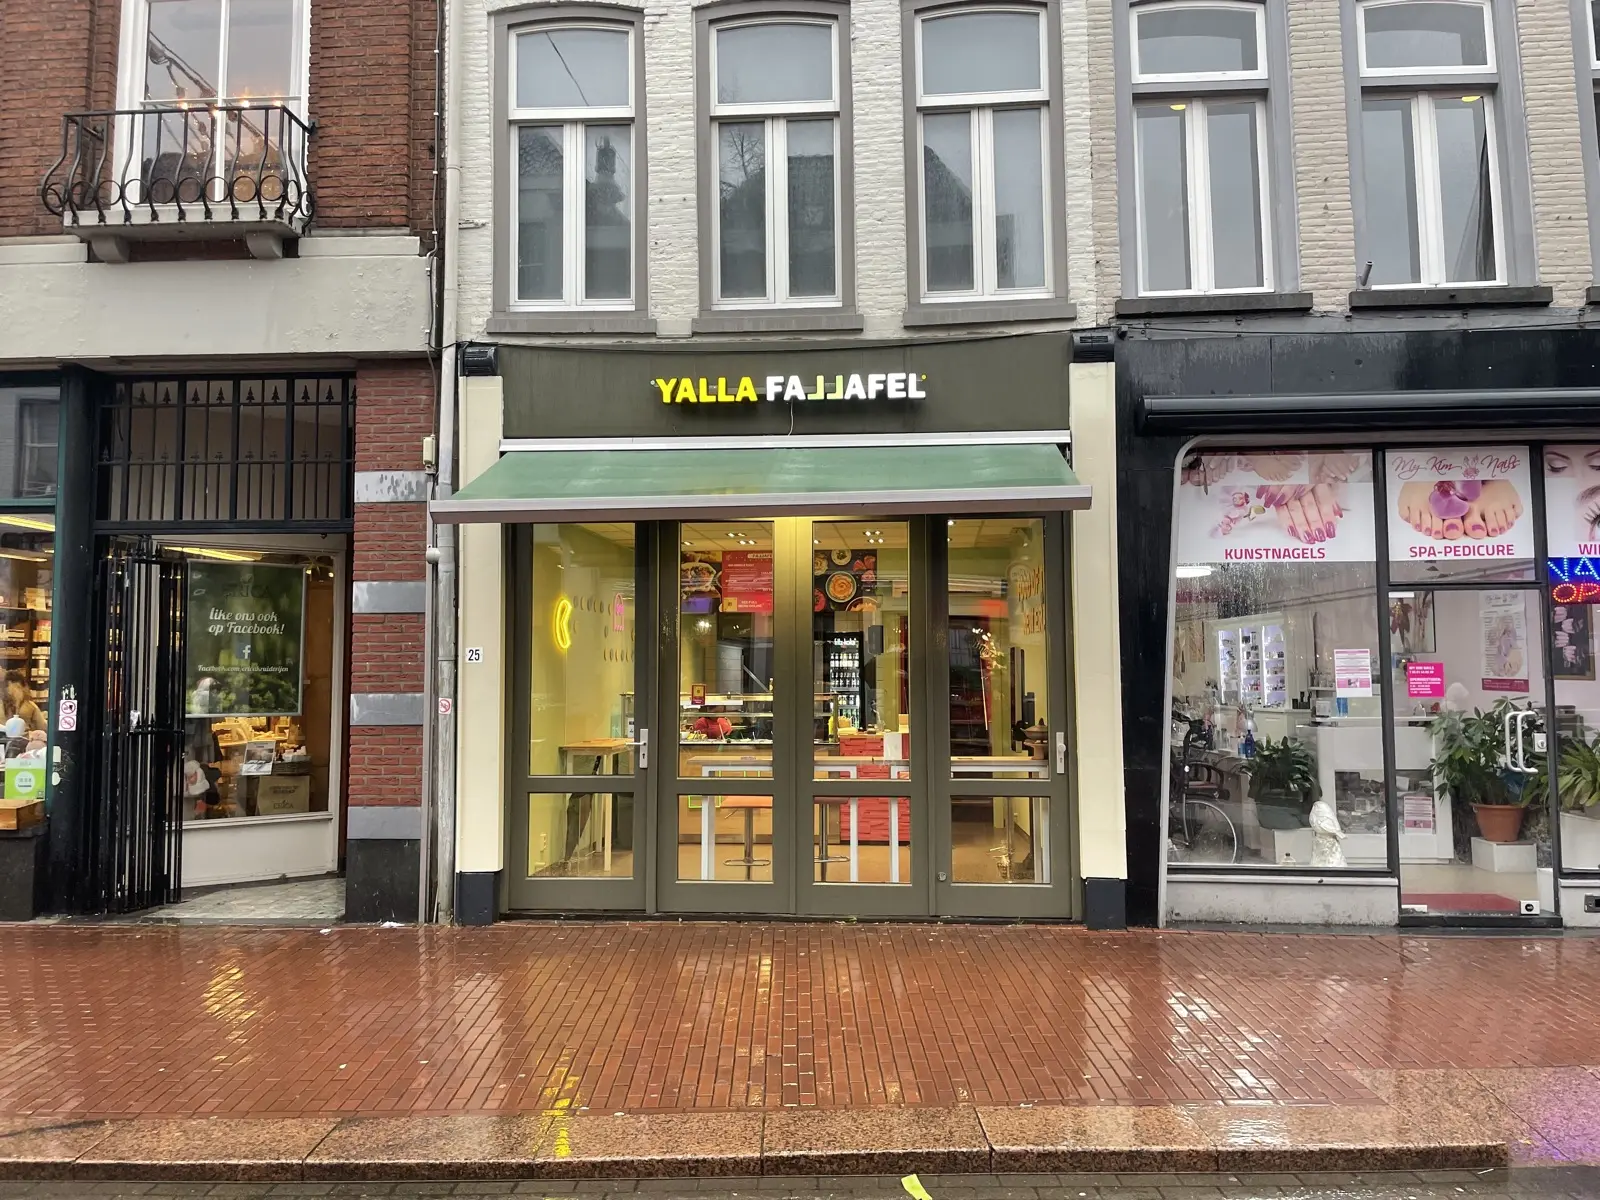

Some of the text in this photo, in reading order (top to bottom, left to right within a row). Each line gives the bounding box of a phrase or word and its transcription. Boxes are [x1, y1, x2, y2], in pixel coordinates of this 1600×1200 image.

[656, 376, 758, 403] YALLA
[1392, 454, 1520, 480] My Kim Nails
[1224, 547, 1326, 560] KUNSTNAGELS
[1409, 543, 1515, 559] SPA-PEDICURE
[1578, 543, 1600, 556] WI
[209, 607, 278, 622] like ons ook
[208, 621, 285, 636] op Facebook!
[468, 649, 480, 661] 25
